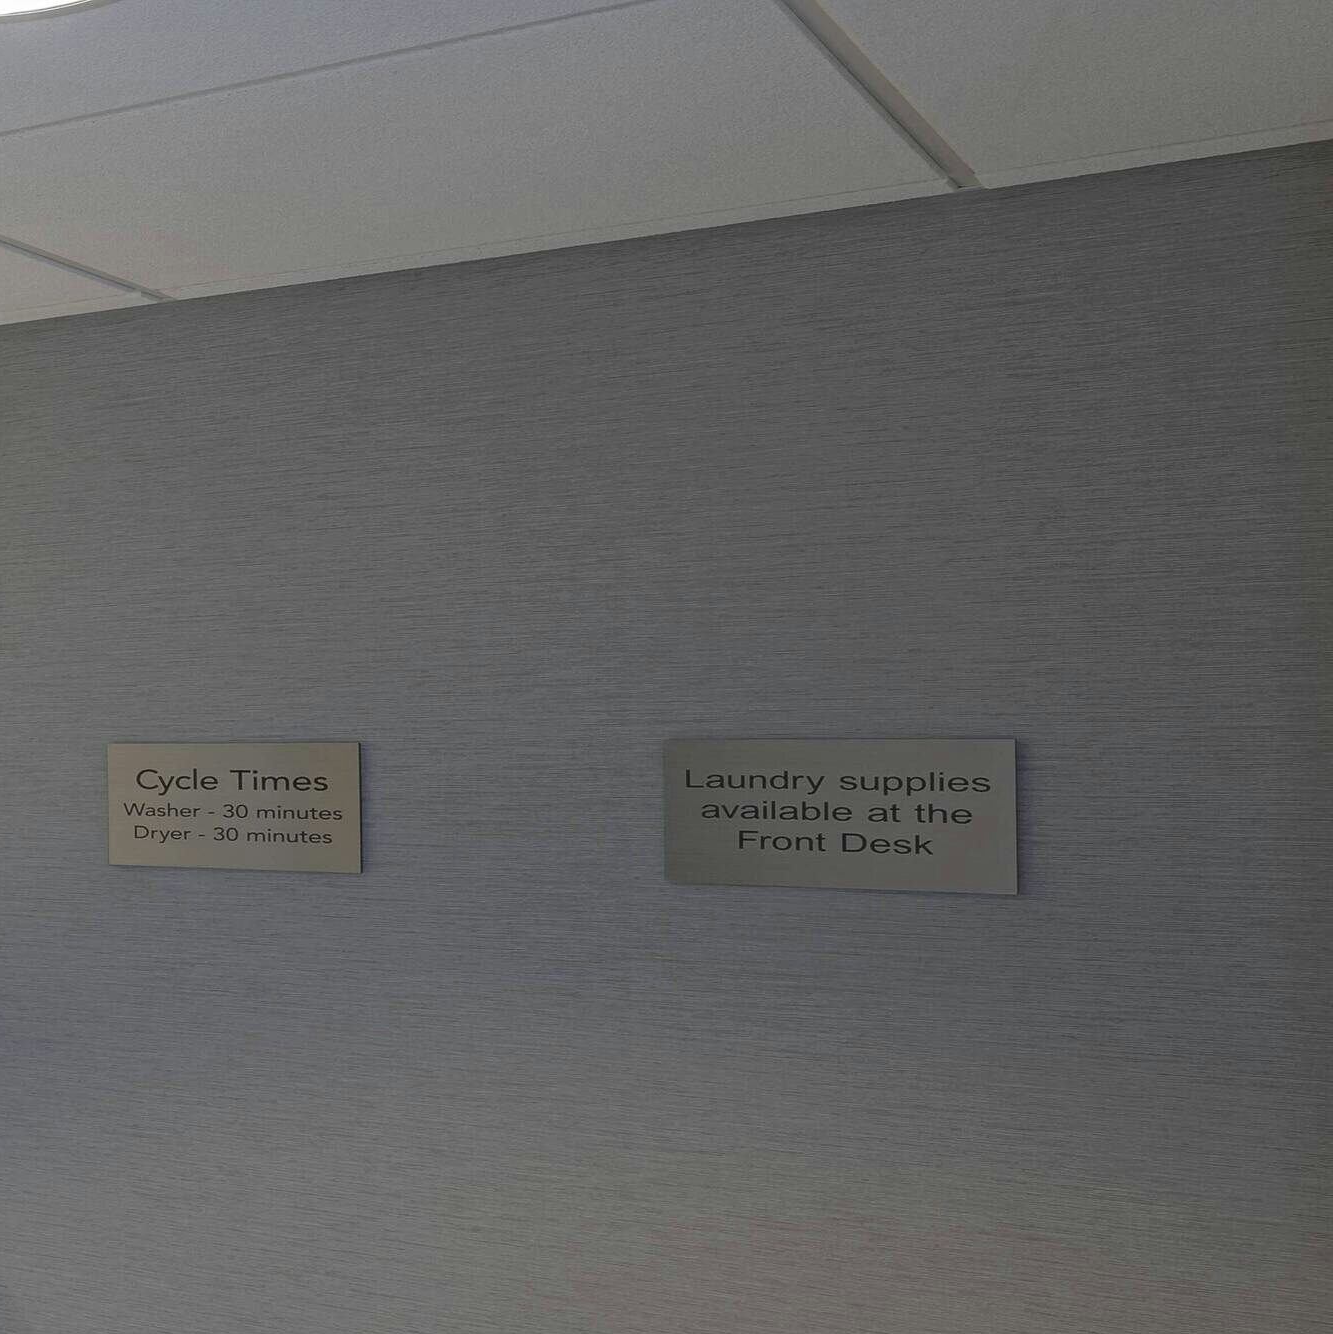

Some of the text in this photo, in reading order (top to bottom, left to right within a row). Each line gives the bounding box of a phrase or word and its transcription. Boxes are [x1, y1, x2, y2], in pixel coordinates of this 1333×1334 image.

[135, 768, 329, 796] Cycle Times
[684, 768, 991, 797] Laundry supplies
[123, 802, 201, 818] Washer
[222, 804, 248, 819] 30
[256, 805, 343, 821] minutes
[700, 800, 973, 825] available at the
[134, 825, 191, 844] Dryer
[213, 827, 239, 842] 30
[246, 828, 333, 844] minutes
[737, 829, 934, 856] Front Desk
